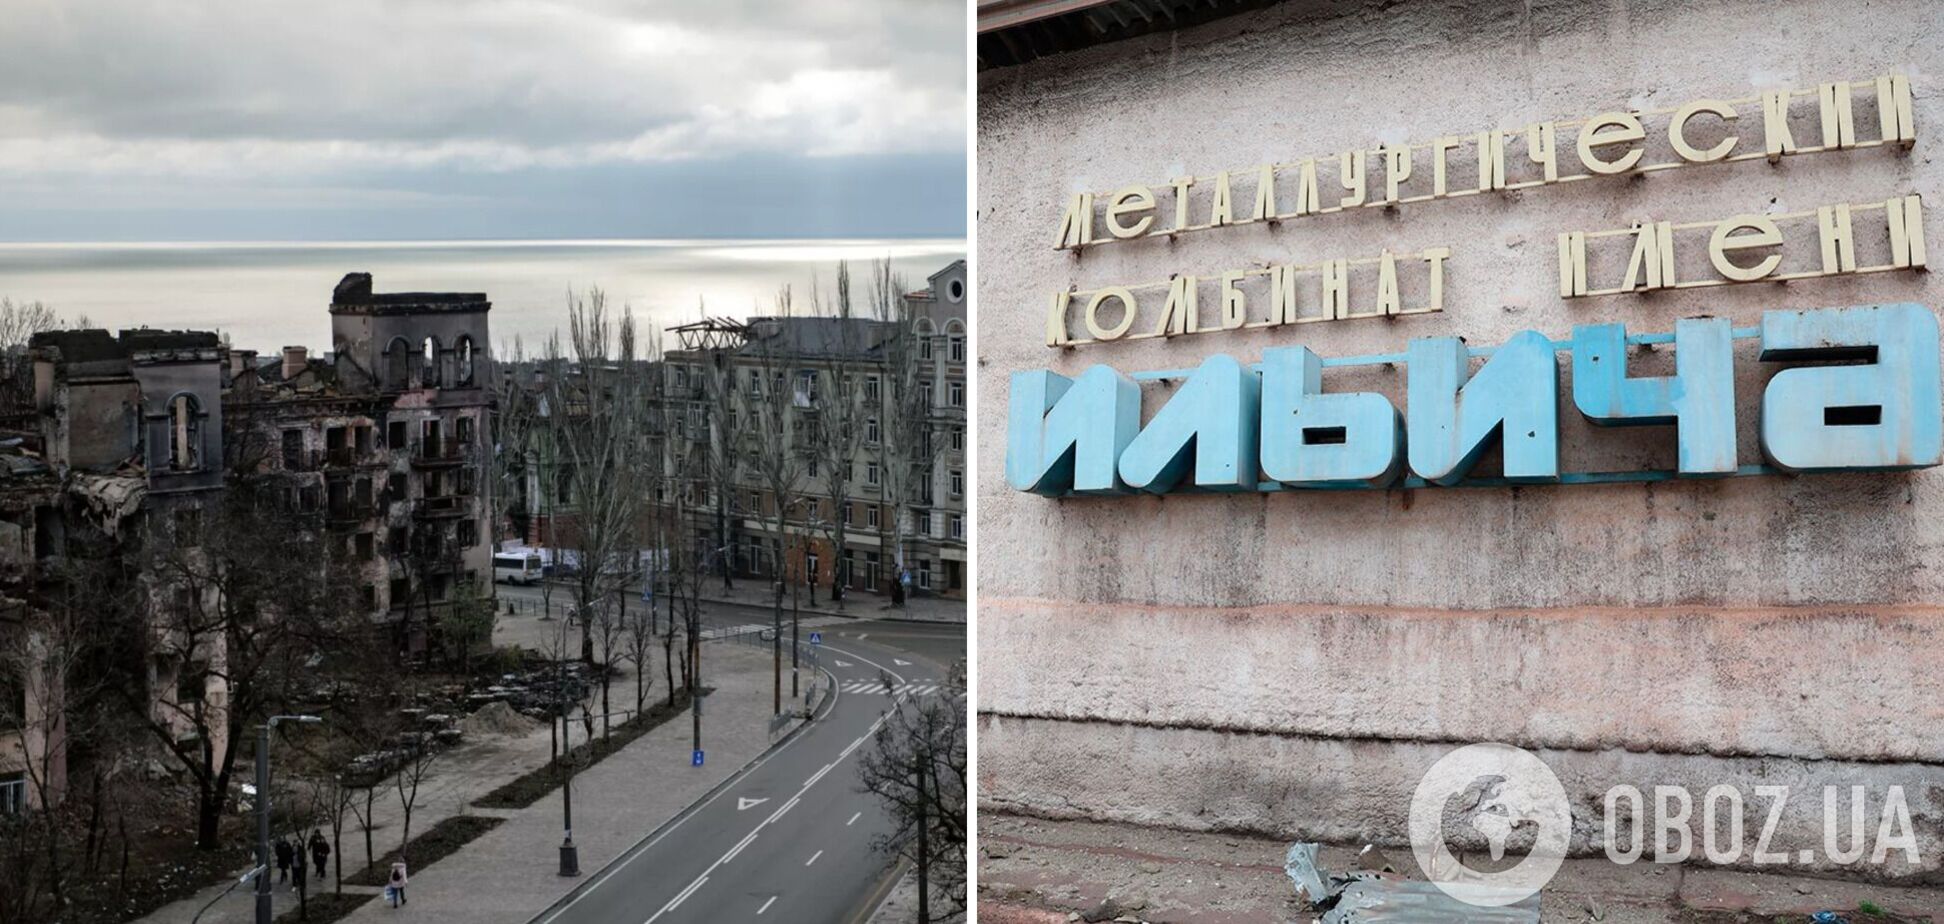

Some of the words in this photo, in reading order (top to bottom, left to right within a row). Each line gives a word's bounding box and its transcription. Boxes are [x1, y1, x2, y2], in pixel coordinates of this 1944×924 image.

[1047, 247, 1450, 348] КОМБИНАТ
[1558, 195, 1926, 299] ИМЕНИ
[1006, 303, 1942, 497] ИЛЬИЧА
